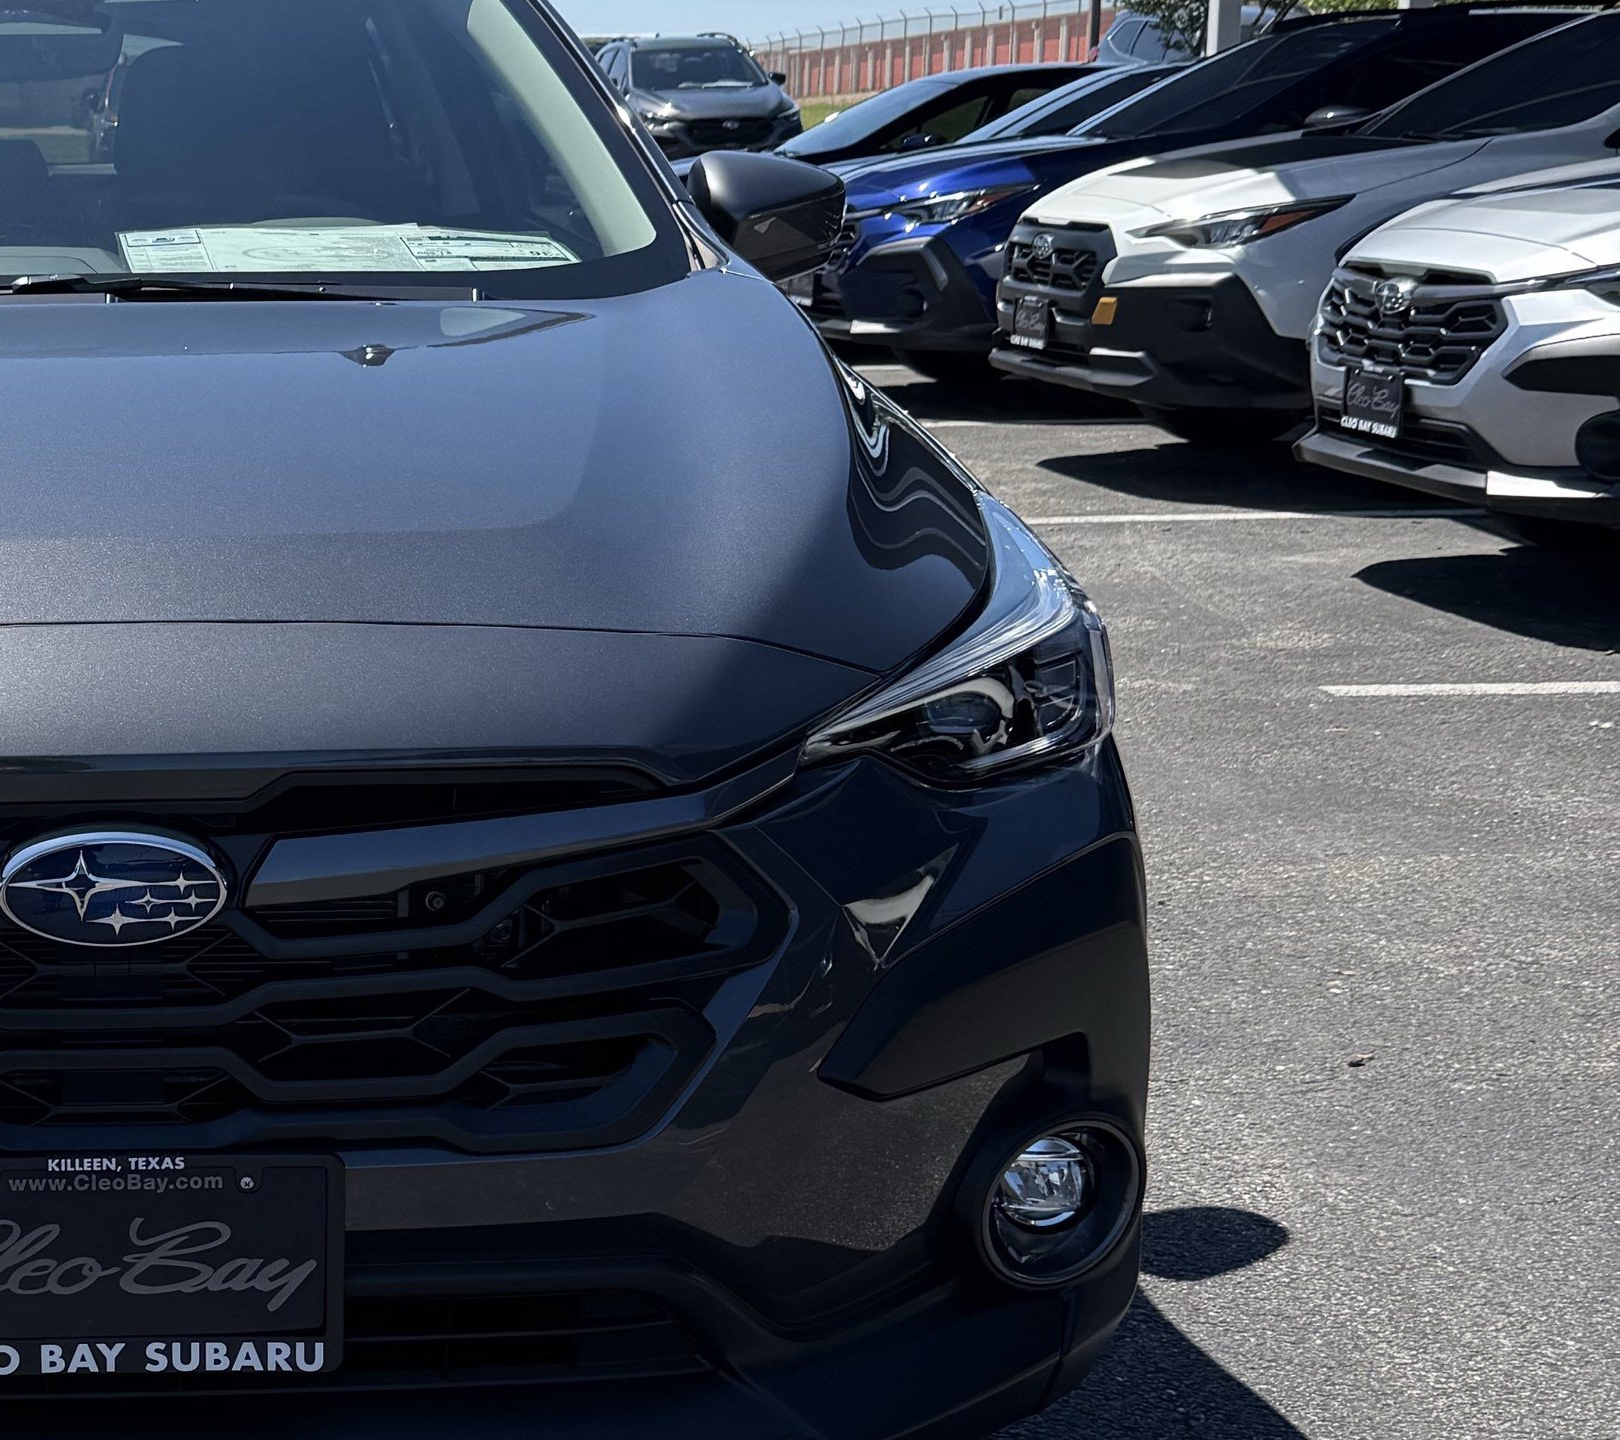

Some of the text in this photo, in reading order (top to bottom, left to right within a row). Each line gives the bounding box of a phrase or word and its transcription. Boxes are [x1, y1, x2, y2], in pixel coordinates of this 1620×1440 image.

[47, 1156, 185, 1172] KILLEEN, TEXAS
[8, 1172, 223, 1194] www.CleoBay.com
[118, 1216, 318, 1313] Bay
[40, 1342, 126, 1374] BAY
[144, 1341, 324, 1373] SUBARU
